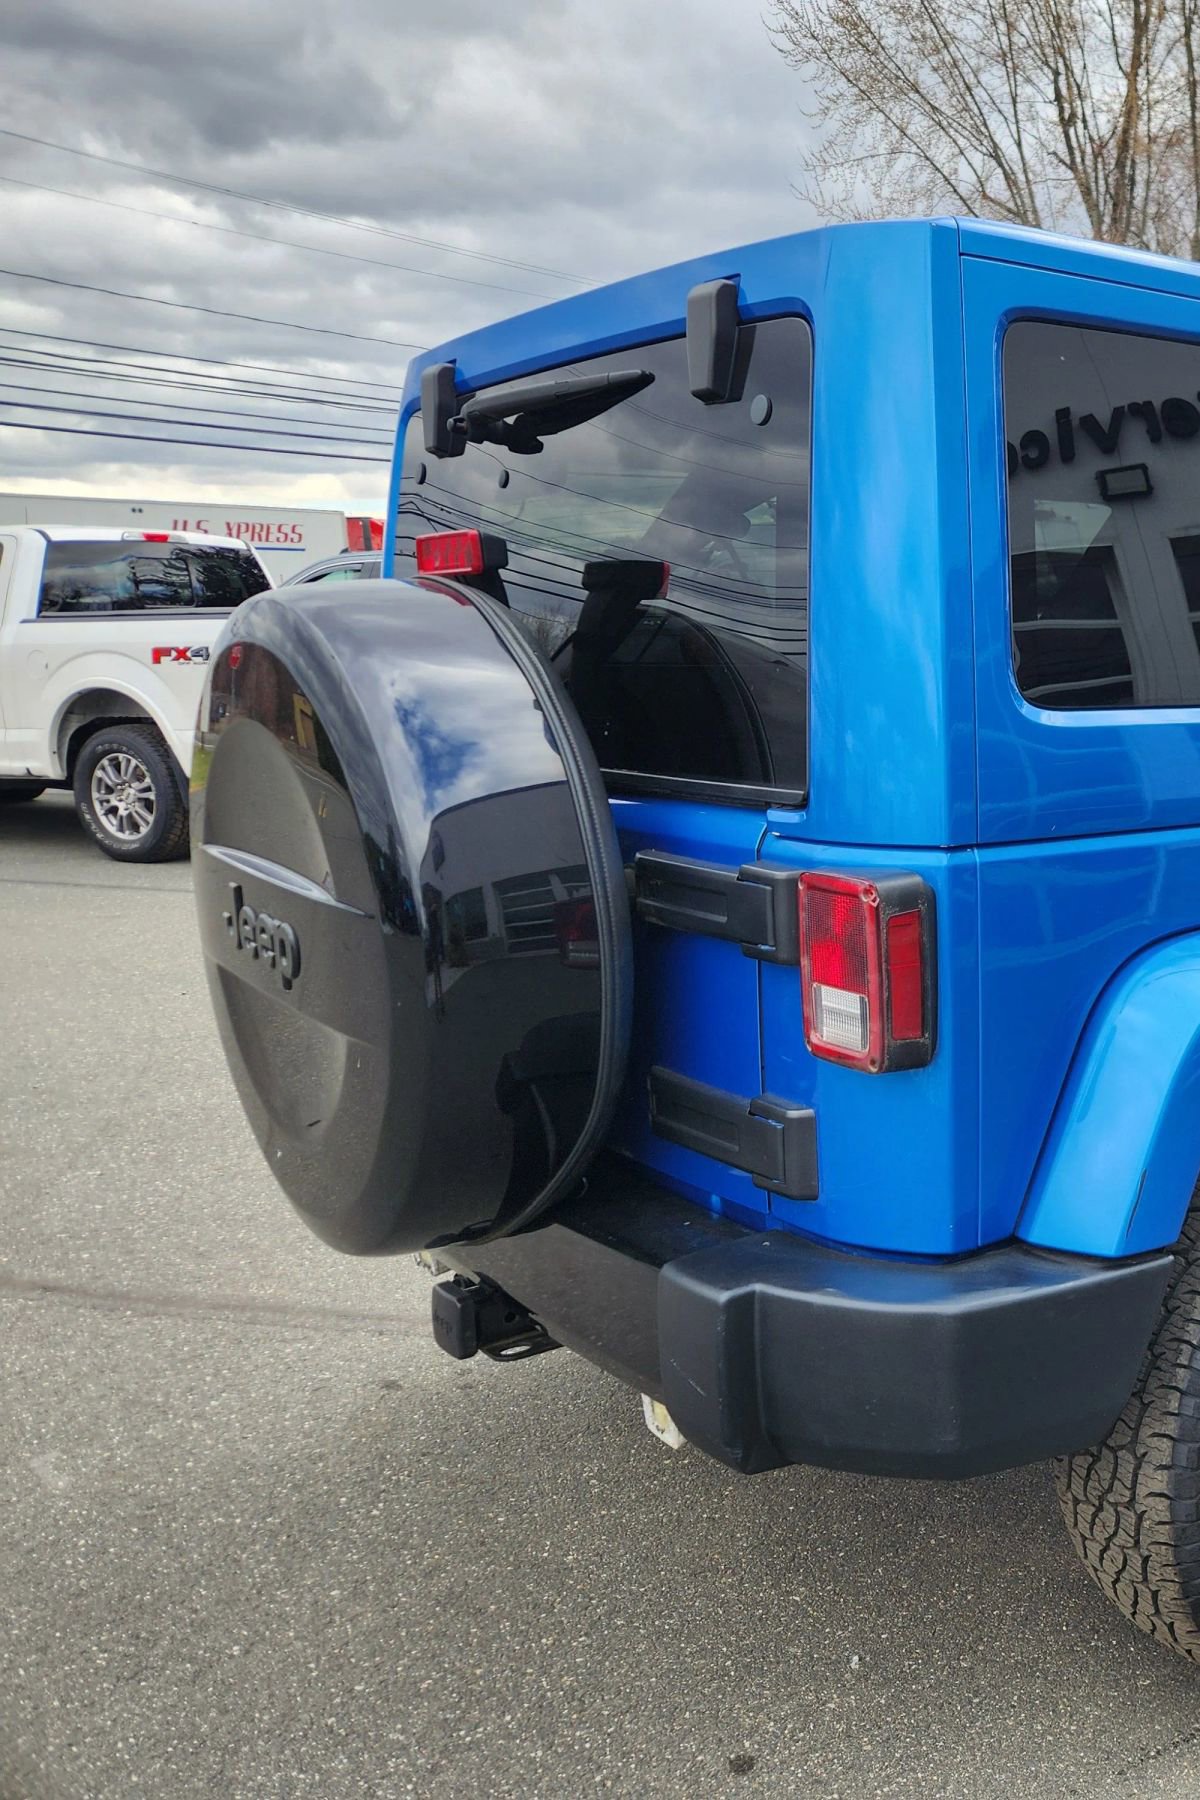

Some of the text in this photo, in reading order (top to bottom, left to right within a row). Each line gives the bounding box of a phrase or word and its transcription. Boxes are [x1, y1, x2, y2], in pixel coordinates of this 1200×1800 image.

[225, 521, 304, 544] XPRESS
[151, 646, 210, 664] FX4
[222, 881, 301, 991] Jeep
